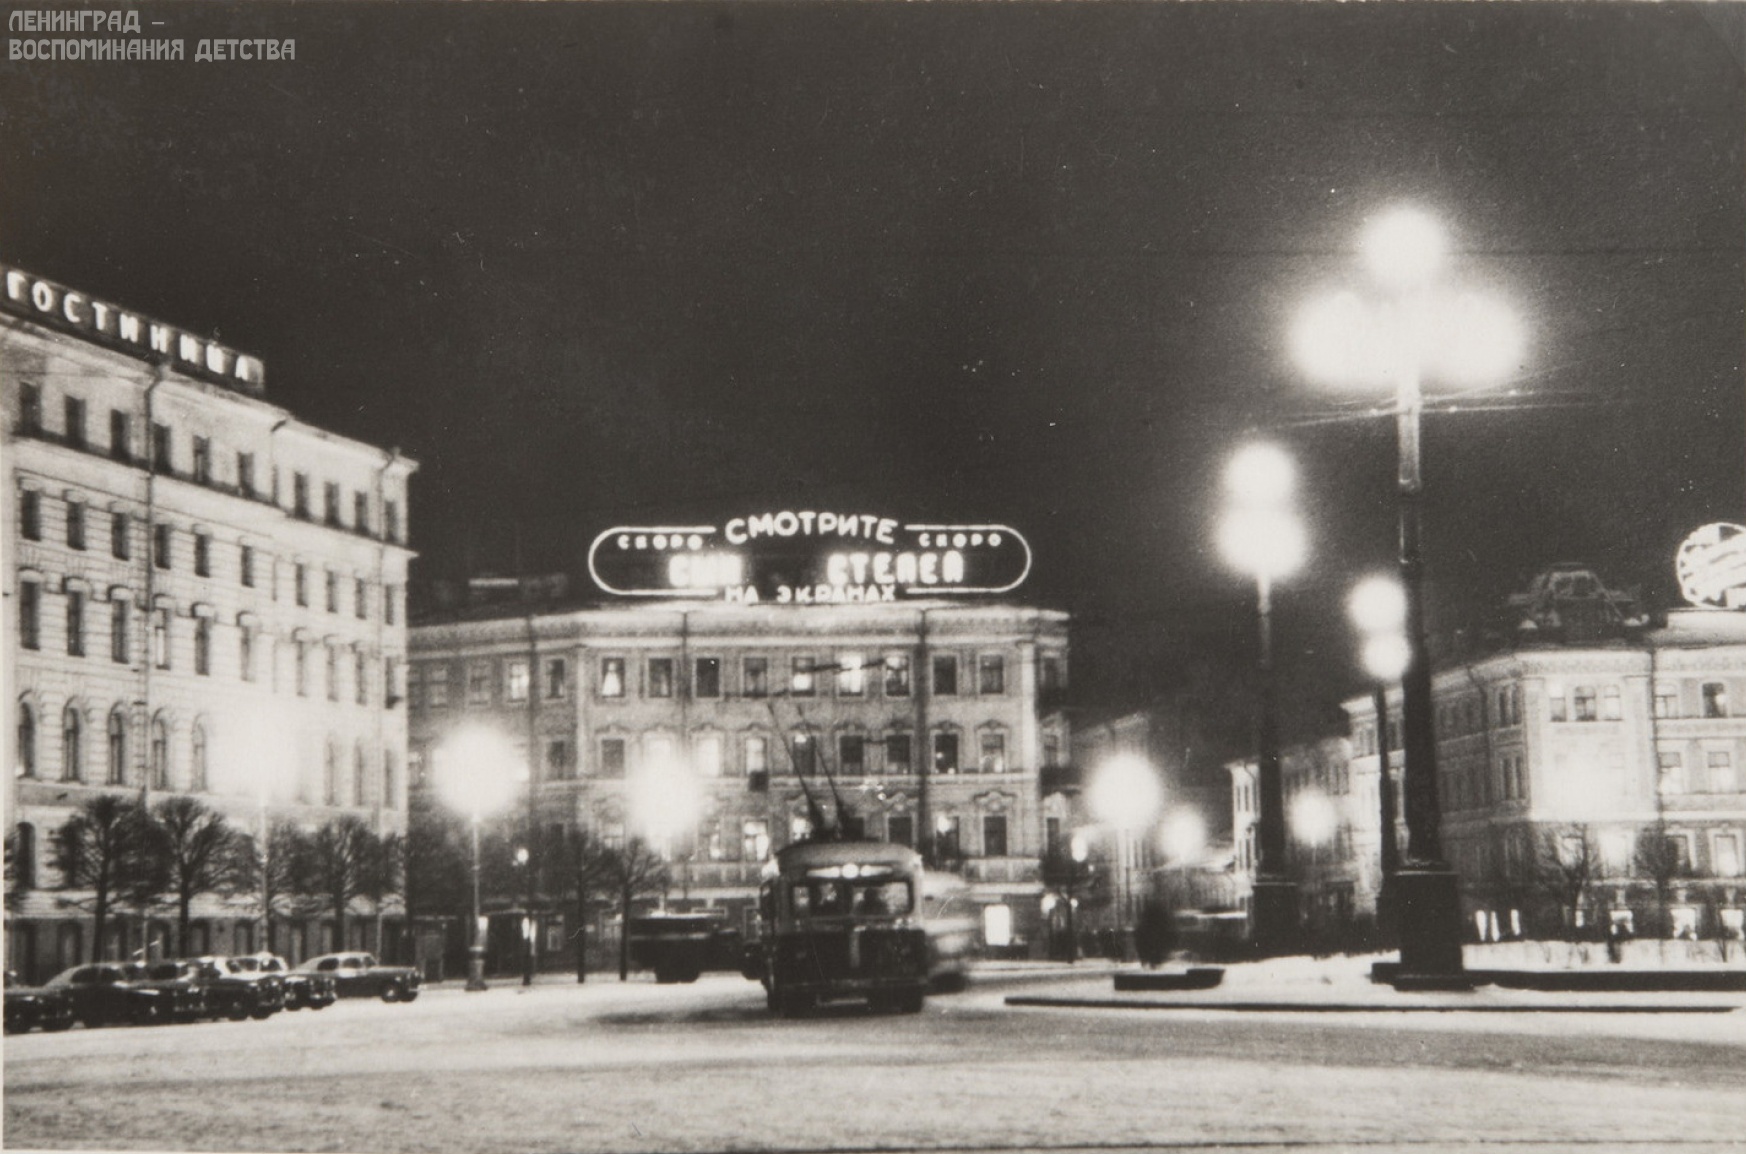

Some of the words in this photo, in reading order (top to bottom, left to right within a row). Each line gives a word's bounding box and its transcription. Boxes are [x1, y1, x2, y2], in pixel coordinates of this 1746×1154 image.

[725, 511, 898, 545] СМОТРИТЕ
[618, 534, 703, 550] СКОРО
[919, 533, 1002, 547] СКОРО
[725, 585, 759, 603] НА
[777, 584, 896, 604] ЭКРАНАХ
